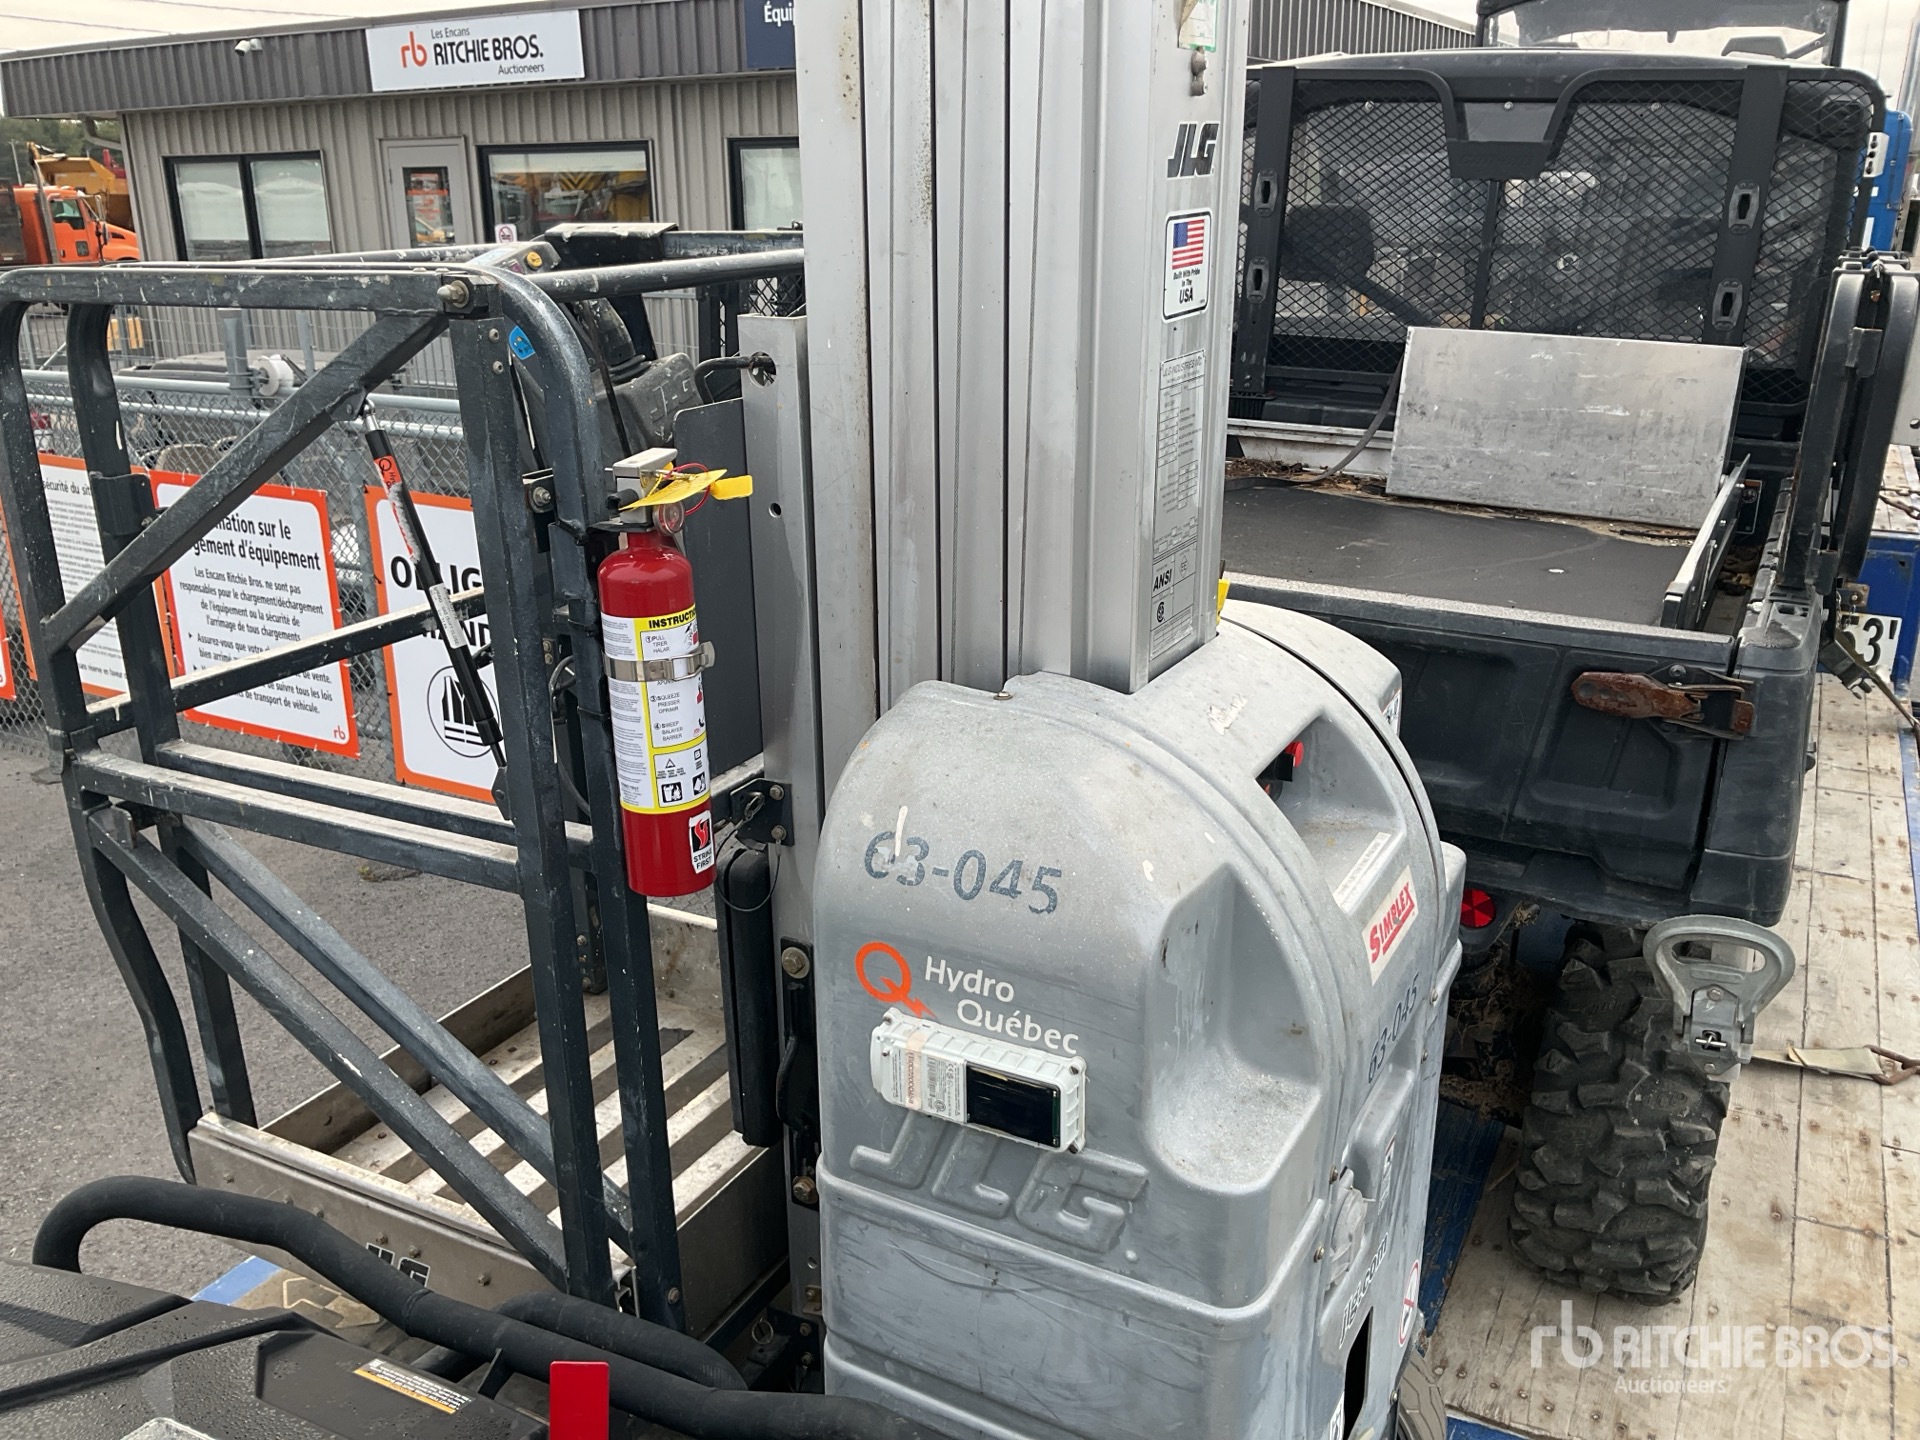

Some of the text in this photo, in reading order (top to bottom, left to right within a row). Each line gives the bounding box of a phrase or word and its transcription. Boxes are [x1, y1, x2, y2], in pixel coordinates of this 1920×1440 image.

[431, 27, 470, 39] Les Encans
[433, 34, 544, 66] RITCHIE BROS.
[498, 64, 546, 75] Auctioneers
[1167, 122, 1220, 179] JLG
[1179, 287, 1193, 304] USA
[70, 483, 80, 494] du
[258, 522, 276, 537] sur
[279, 519, 291, 540] le
[238, 540, 321, 571] d'équipement
[180, 581, 217, 596] responsables
[218, 588, 232, 600] pour
[232, 588, 239, 599] le
[194, 566, 301, 595] Les Encans Ritchie Bros. ne sont pas
[1153, 569, 1172, 591] ANSI
[200, 599, 300, 627] de l'équipement ou la sécurité de
[238, 621, 246, 632] de
[246, 623, 260, 635] tous
[261, 625, 301, 642] chargements
[197, 633, 234, 649] Assurez-vous
[235, 642, 246, 652] que
[198, 647, 211, 658] bien
[312, 673, 332, 684] vente.
[276, 681, 294, 693] suivre
[296, 686, 310, 696] tous
[311, 687, 320, 699] les
[321, 689, 333, 701] lois
[658, 692, 680, 700] SQUEEZE
[254, 691, 282, 706] transport
[284, 698, 291, 708] de
[292, 700, 320, 714] véhicule.
[658, 699, 680, 707] PRESSER
[662, 726, 683, 735] BALAYER
[696, 858, 712, 870] FIRST
[864, 831, 1062, 914] 63-045
[1369, 882, 1414, 964] SIMPLEX
[925, 956, 1014, 1003] Hydro
[957, 999, 1079, 1055] Québec
[1368, 972, 1419, 1085] 63-045
